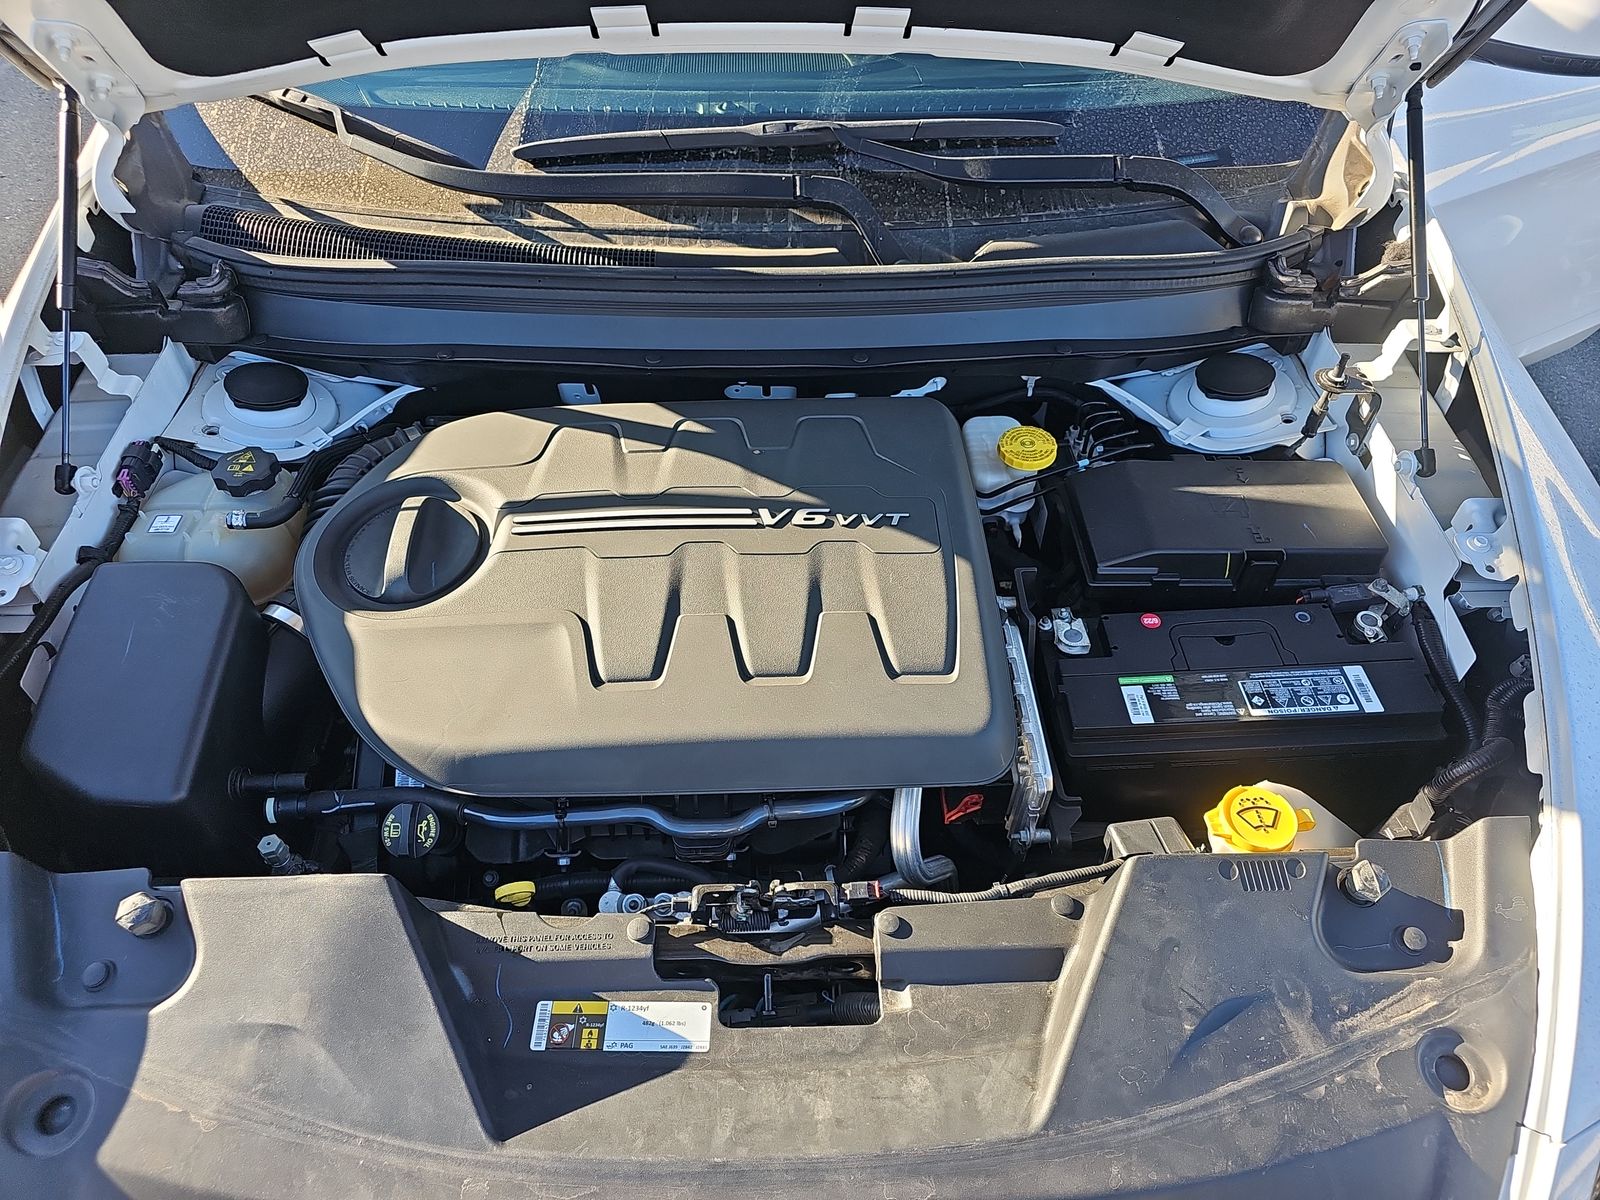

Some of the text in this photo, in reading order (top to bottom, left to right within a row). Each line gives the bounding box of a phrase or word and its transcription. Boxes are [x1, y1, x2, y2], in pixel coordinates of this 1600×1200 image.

[757, 508, 910, 526] V6 VVT
[385, 813, 395, 826] SAE
[423, 813, 436, 848] ENGINE OIL
[510, 935, 528, 943] THIS
[529, 934, 553, 942] PANEL
[555, 933, 572, 942] FOR
[571, 933, 602, 941] ACCESS
[535, 944, 548, 952] ON
[574, 942, 612, 950] VEHICLES
